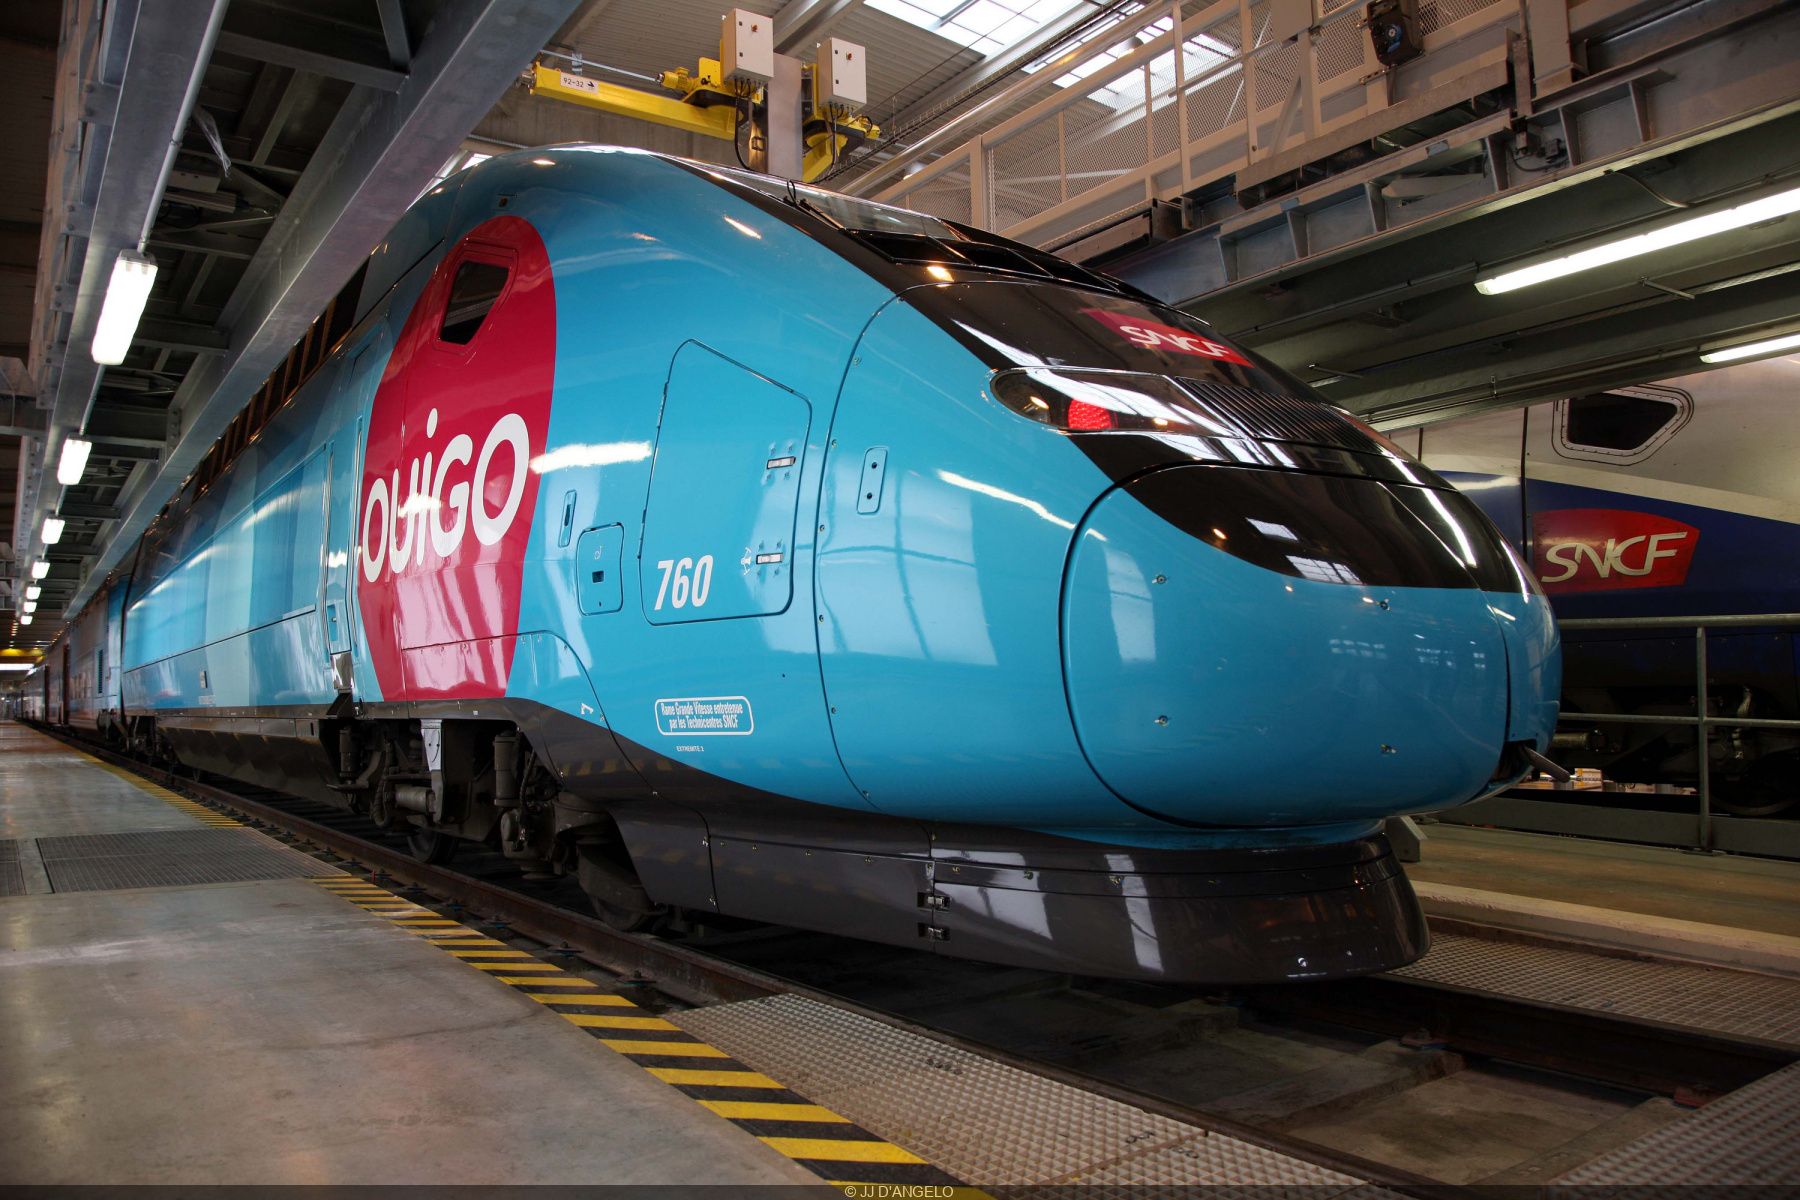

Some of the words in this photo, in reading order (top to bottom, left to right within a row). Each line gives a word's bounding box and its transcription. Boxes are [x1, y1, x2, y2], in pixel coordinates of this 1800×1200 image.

[563, 78, 584, 88] 92-32
[1119, 325, 1230, 357] SNCF
[1540, 531, 1688, 583] SNCF
[654, 554, 714, 611] 760
[661, 702, 675, 715] Rame
[675, 702, 693, 715] Grande
[693, 701, 713, 715] Vitesse
[713, 702, 743, 714] entretenue
[669, 719, 678, 732] par
[677, 716, 686, 729] les
[685, 715, 723, 729] Technicentres
[723, 714, 738, 728] SNCF
